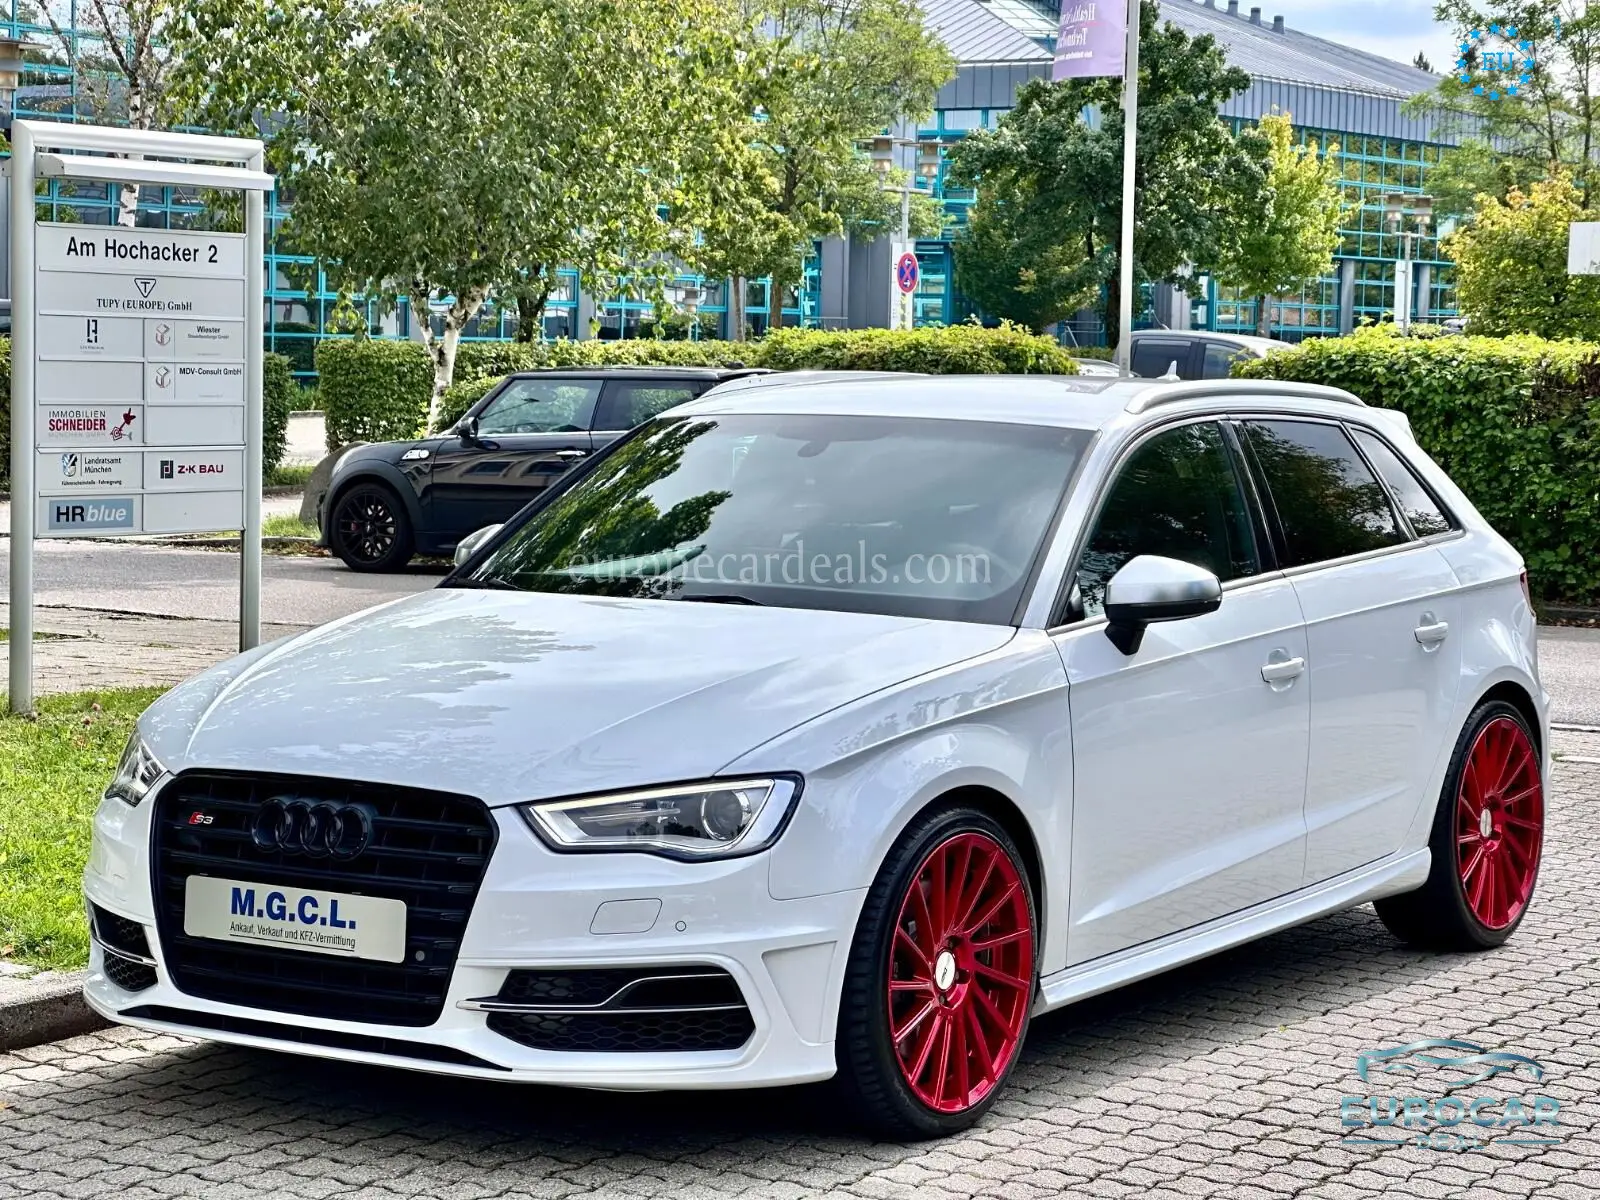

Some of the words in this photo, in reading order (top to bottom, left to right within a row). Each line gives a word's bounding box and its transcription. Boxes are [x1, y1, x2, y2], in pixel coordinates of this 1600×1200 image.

[66, 236, 96, 257] Am
[104, 238, 200, 263] Hochacker
[207, 244, 219, 264] 2
[96, 298, 121, 309] TUPY
[122, 299, 166, 311] (EUROPE)
[167, 301, 193, 311] GmbH
[179, 367, 222, 375] MDV-Consult
[223, 367, 242, 376] GmbH
[48, 410, 106, 418] IMMOBILIEN
[48, 418, 106, 431] SCHNEIDER
[84, 456, 121, 465] Landratsamt
[84, 466, 112, 474] München
[199, 464, 224, 474] BAU
[192, 813, 214, 825] S3
[231, 887, 357, 930] M.G.C.L.
[230, 921, 256, 935] Ankauf,
[257, 925, 285, 938] Verkauf
[285, 929, 298, 940] und
[299, 931, 356, 949] KFZ-Vermittlung
